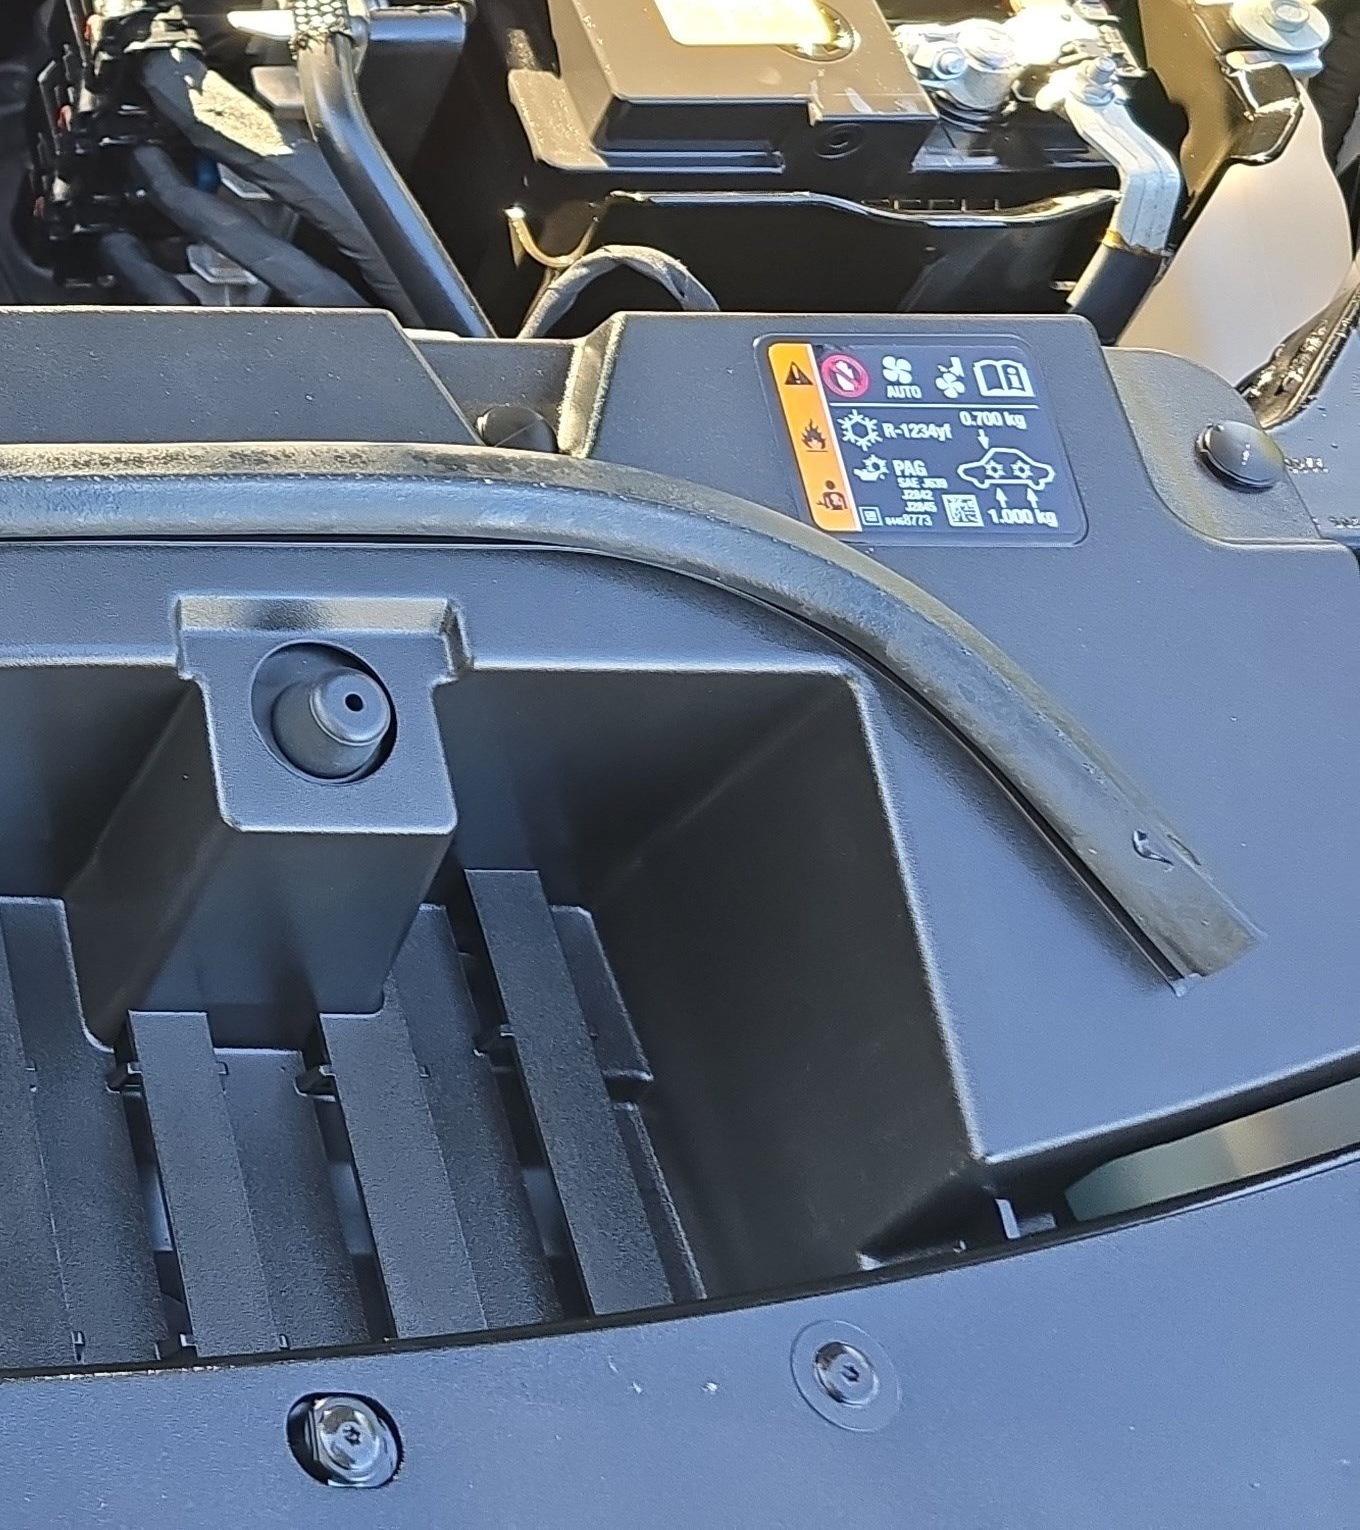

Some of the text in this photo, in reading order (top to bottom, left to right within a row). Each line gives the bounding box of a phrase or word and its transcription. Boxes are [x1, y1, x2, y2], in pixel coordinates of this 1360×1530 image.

[886, 384, 923, 399] AUTO
[958, 411, 1028, 430] 0.700 kg
[882, 422, 953, 442] R-1234yf
[892, 459, 928, 477] PAG
[896, 477, 921, 489] SAE
[987, 508, 1059, 527] 1.000 kg
